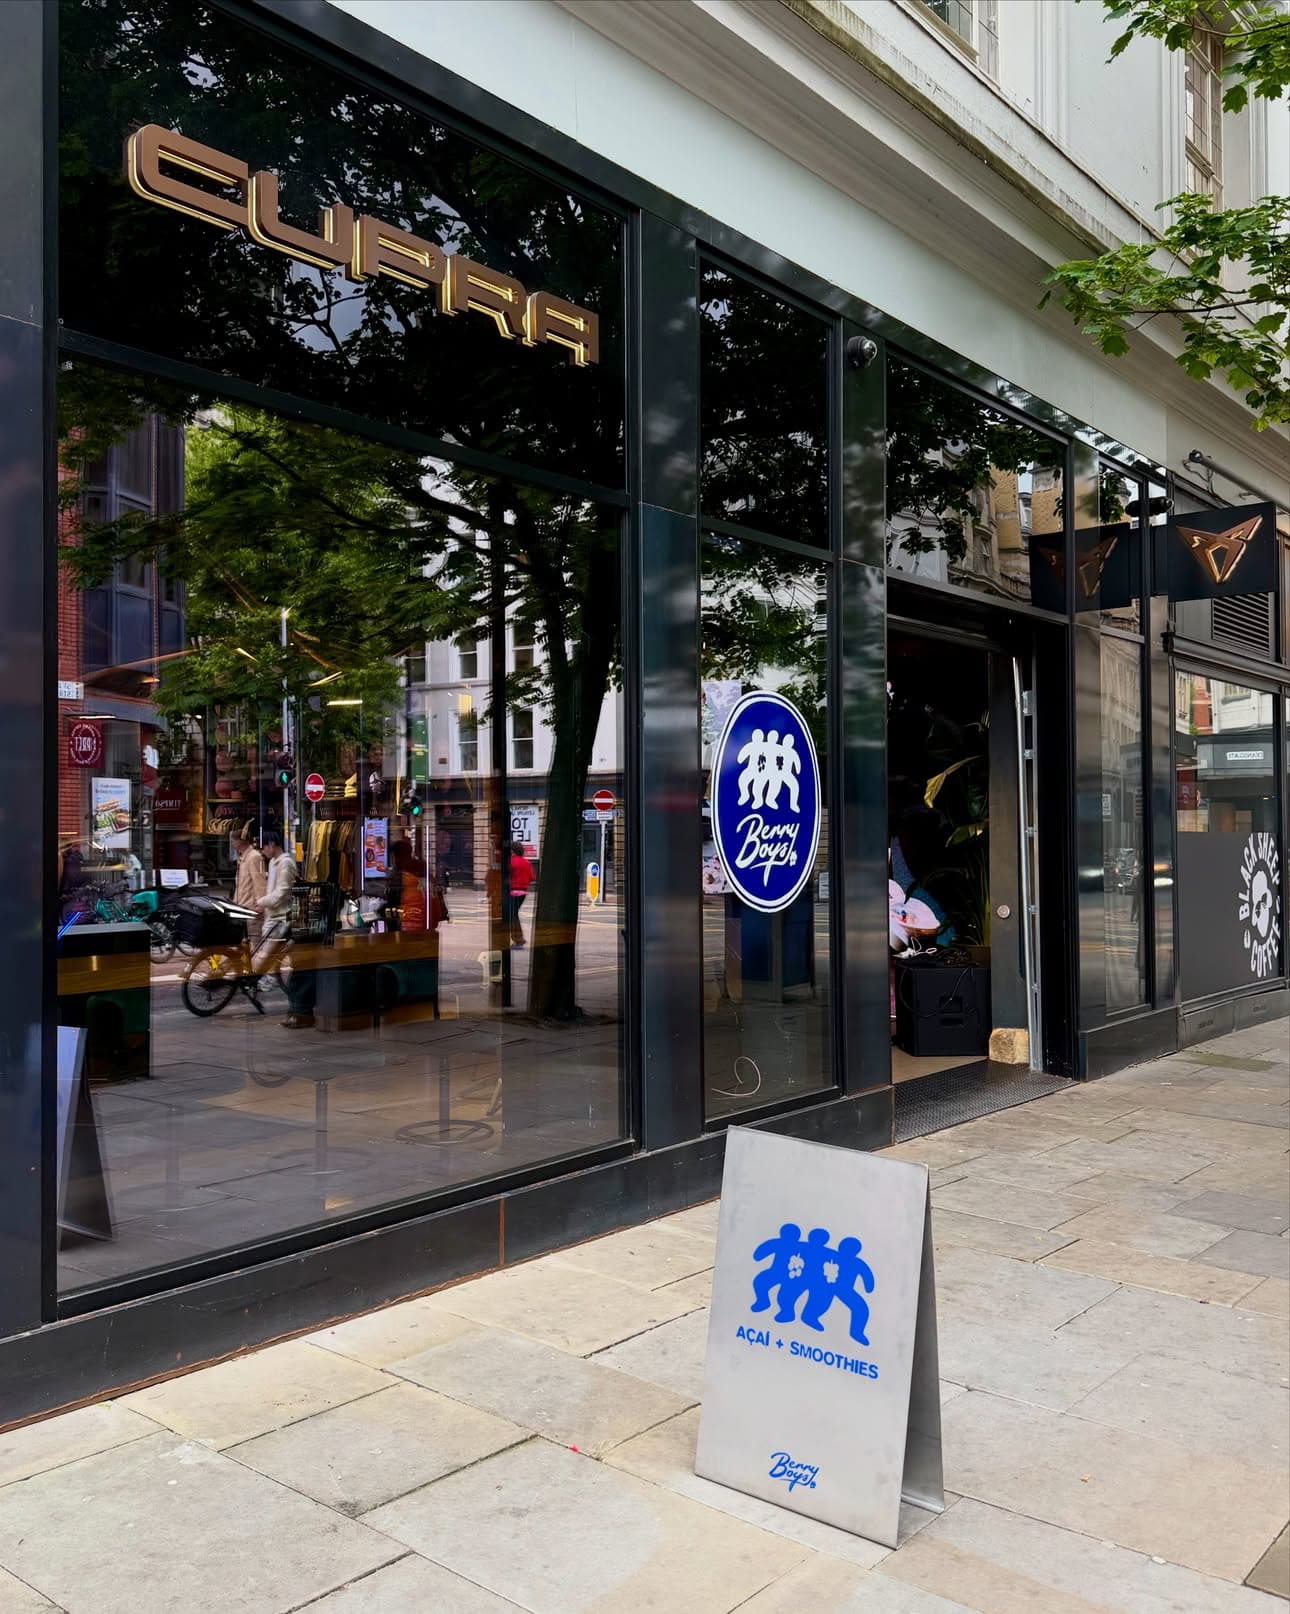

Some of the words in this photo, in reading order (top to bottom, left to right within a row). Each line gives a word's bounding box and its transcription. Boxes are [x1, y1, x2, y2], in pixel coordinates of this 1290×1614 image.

[125, 124, 599, 366] CUPRA
[735, 813, 800, 856] Berry
[734, 836, 796, 887] Boys
[1239, 833, 1258, 920] BLACK
[1250, 915, 1281, 978] COFFEE
[789, 1340, 879, 1379] SMOOTHIES
[769, 1452, 819, 1478] Berry
[769, 1465, 812, 1492] Boys
